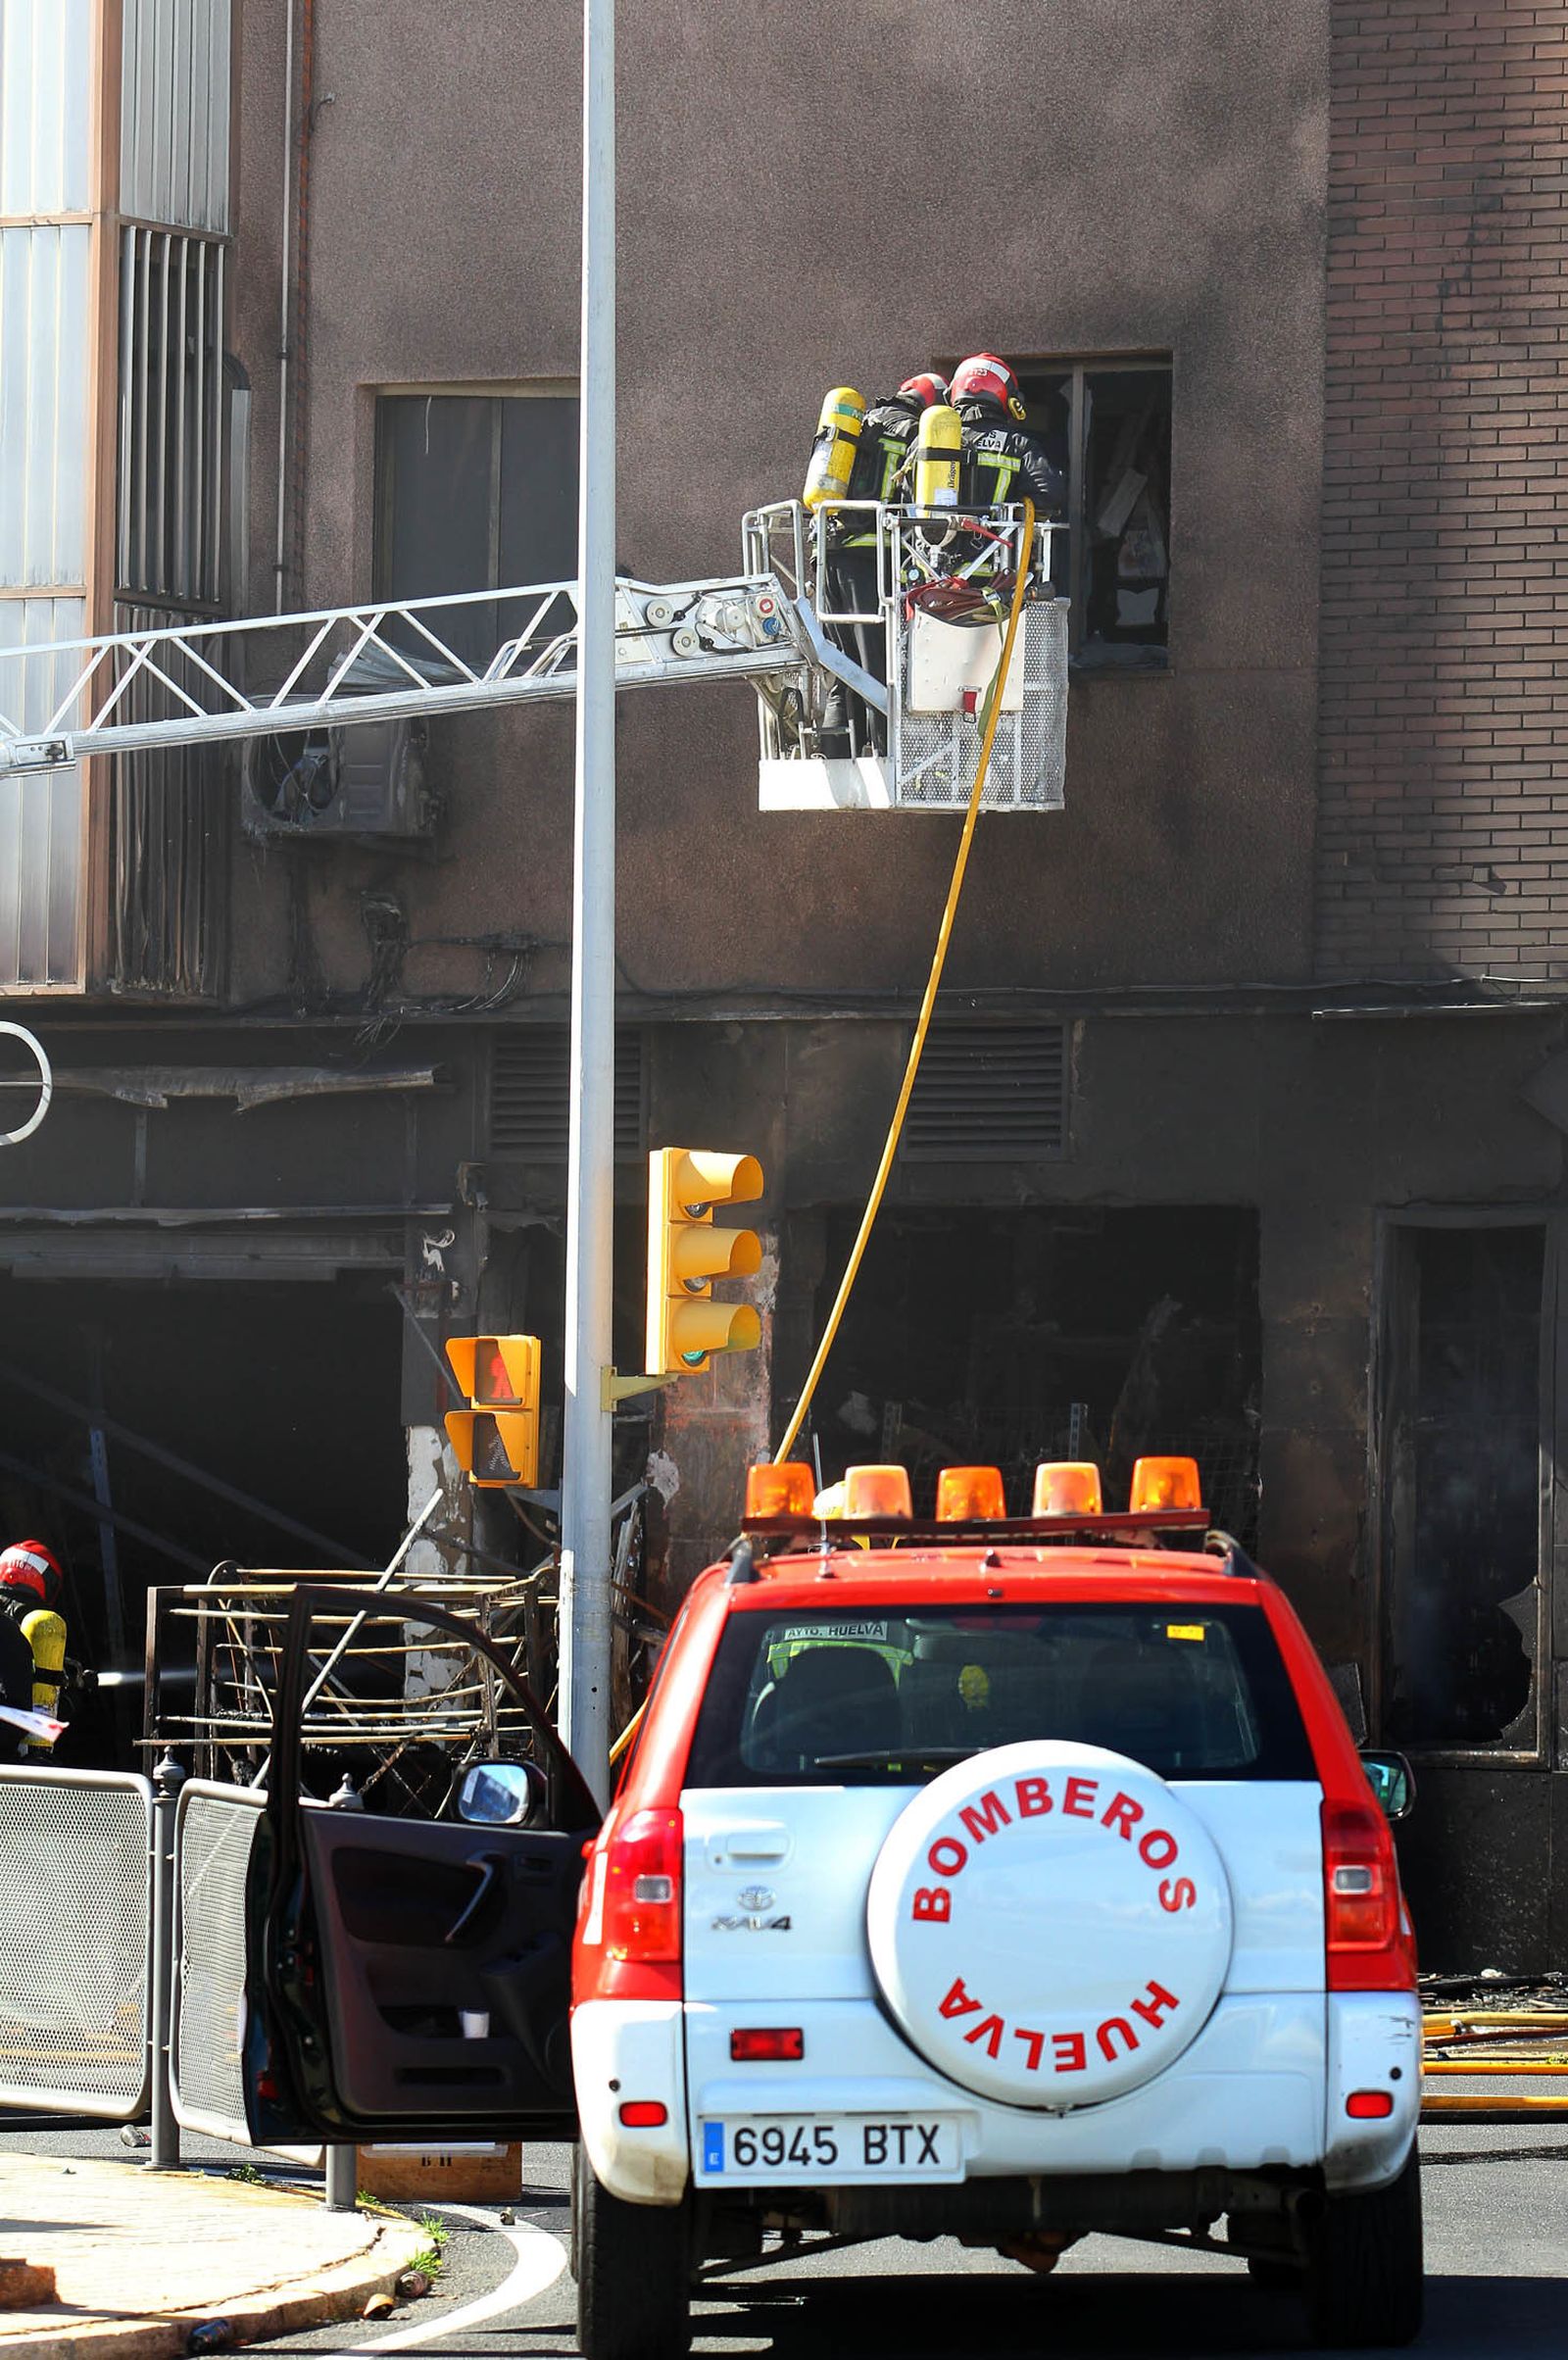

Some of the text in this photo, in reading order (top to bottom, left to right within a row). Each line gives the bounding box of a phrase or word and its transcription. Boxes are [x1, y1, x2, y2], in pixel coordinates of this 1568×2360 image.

[789, 1625, 884, 1637] AYTO. HUELVA
[912, 1776, 1197, 1923] BOMBEROS
[938, 1977, 1180, 2073] HUELVA
[734, 2124, 940, 2166] 6945 BTX
